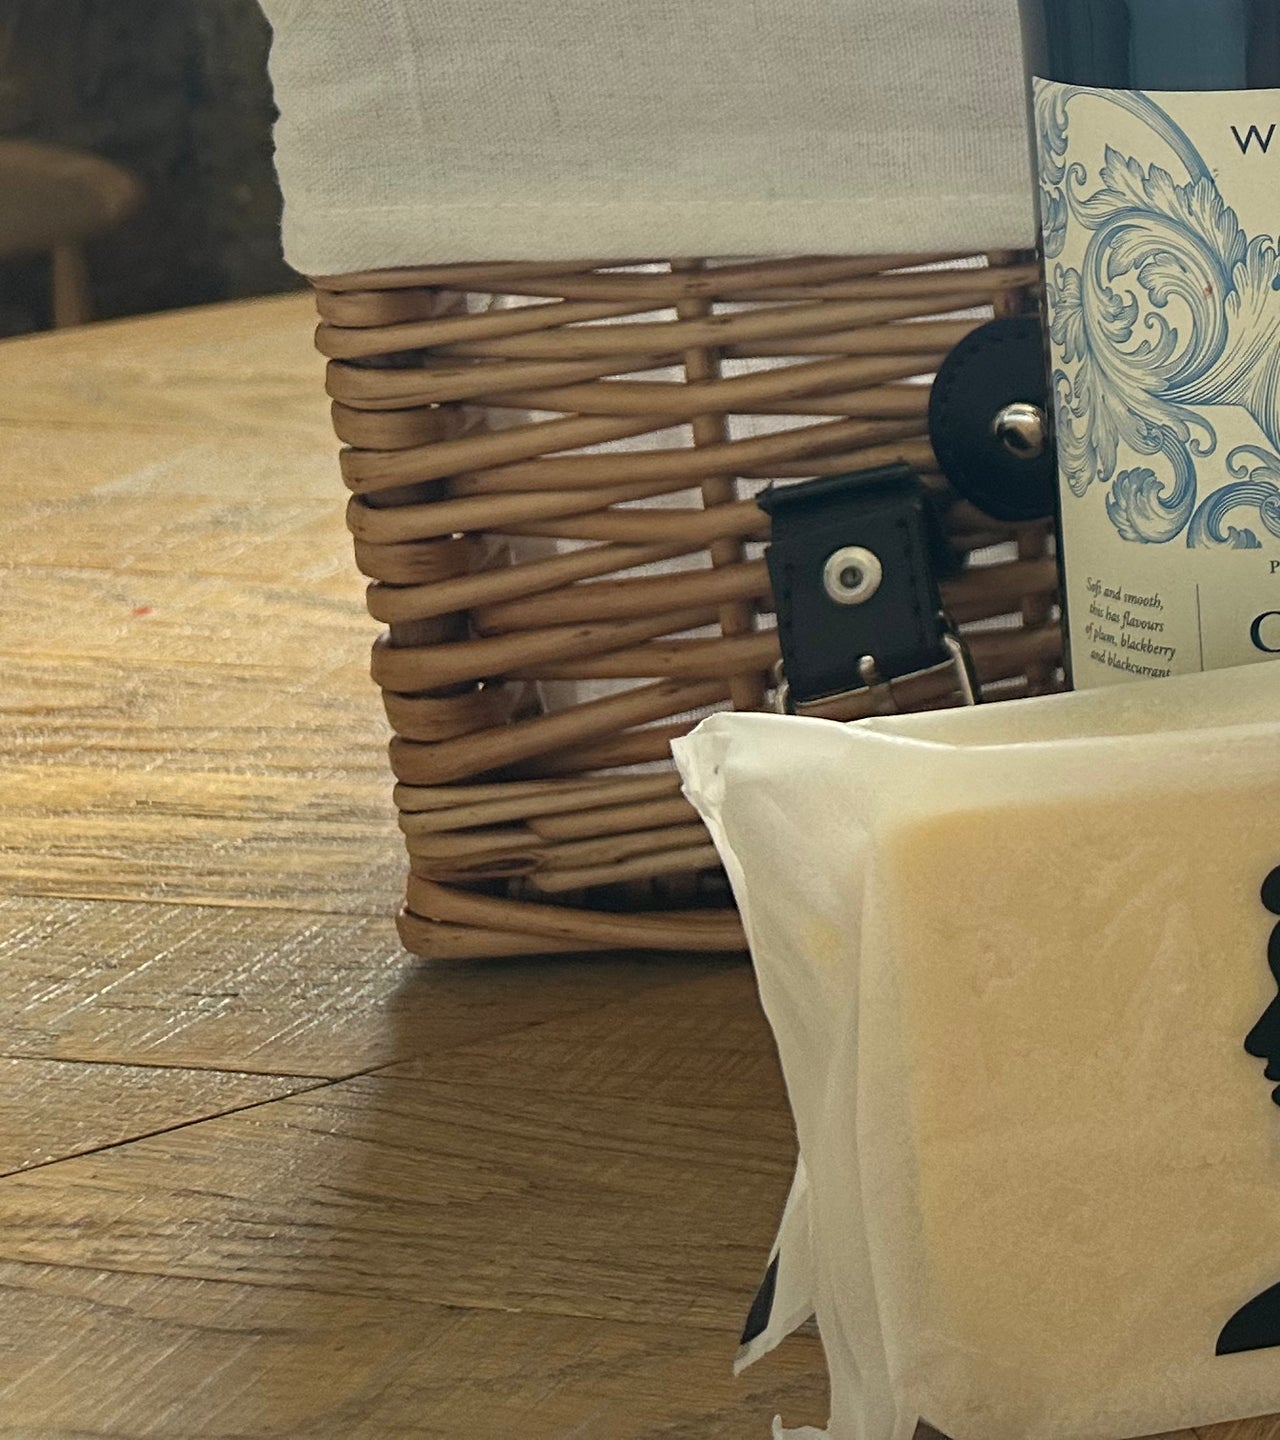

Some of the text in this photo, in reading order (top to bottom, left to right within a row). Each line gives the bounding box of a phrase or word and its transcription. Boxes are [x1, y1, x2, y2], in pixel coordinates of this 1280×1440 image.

[1104, 585, 1121, 601] and
[1124, 592, 1163, 611] smooth,
[1105, 605, 1120, 623] has
[1120, 611, 1164, 632] flavours
[1085, 622, 1094, 639] of
[1120, 632, 1176, 662] blackberry
[1090, 649, 1171, 678] and blackcurrant
